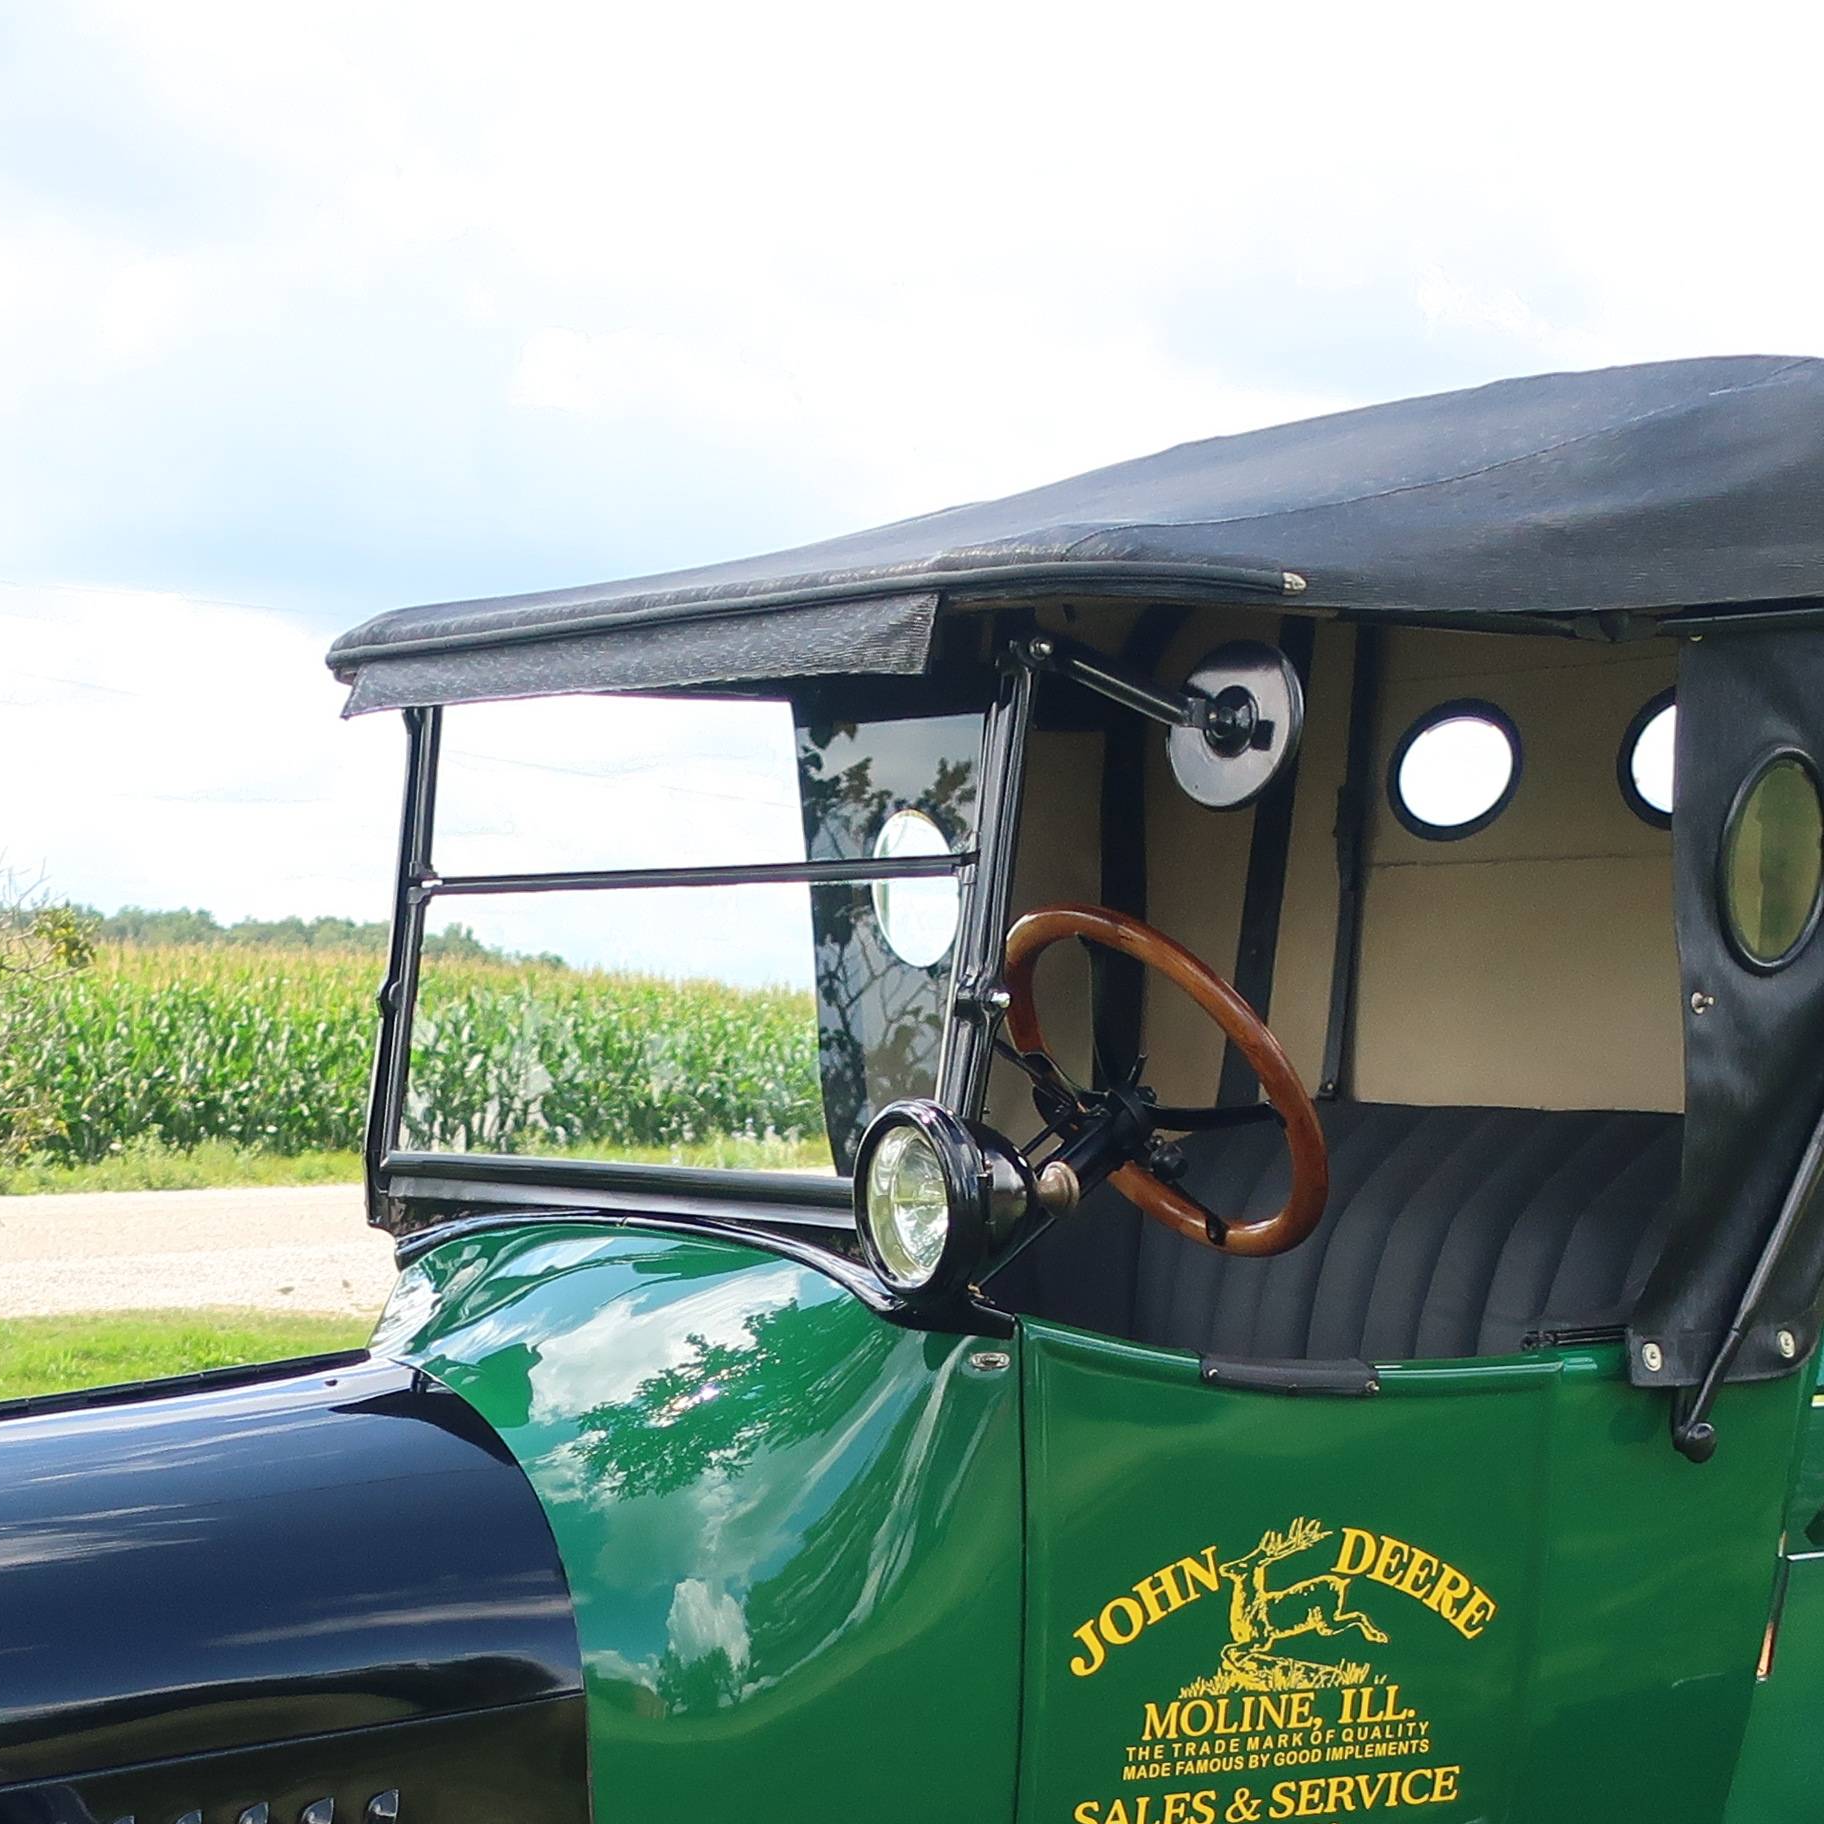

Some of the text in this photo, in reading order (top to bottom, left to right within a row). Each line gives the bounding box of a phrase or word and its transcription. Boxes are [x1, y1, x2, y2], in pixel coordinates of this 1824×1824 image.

[1070, 1527, 1498, 1677] JOHN DEERE
[1125, 1720, 1430, 1762] THE TRADE MARK OF QUALITY
[1141, 1684, 1417, 1741] MOLINE, ILL.
[1122, 1738, 1431, 1781] MADE FAMOUS BY GOOD IMPLEMENTS
[1225, 1786, 1263, 1824] &
[1268, 1765, 1462, 1819] SERVICE
